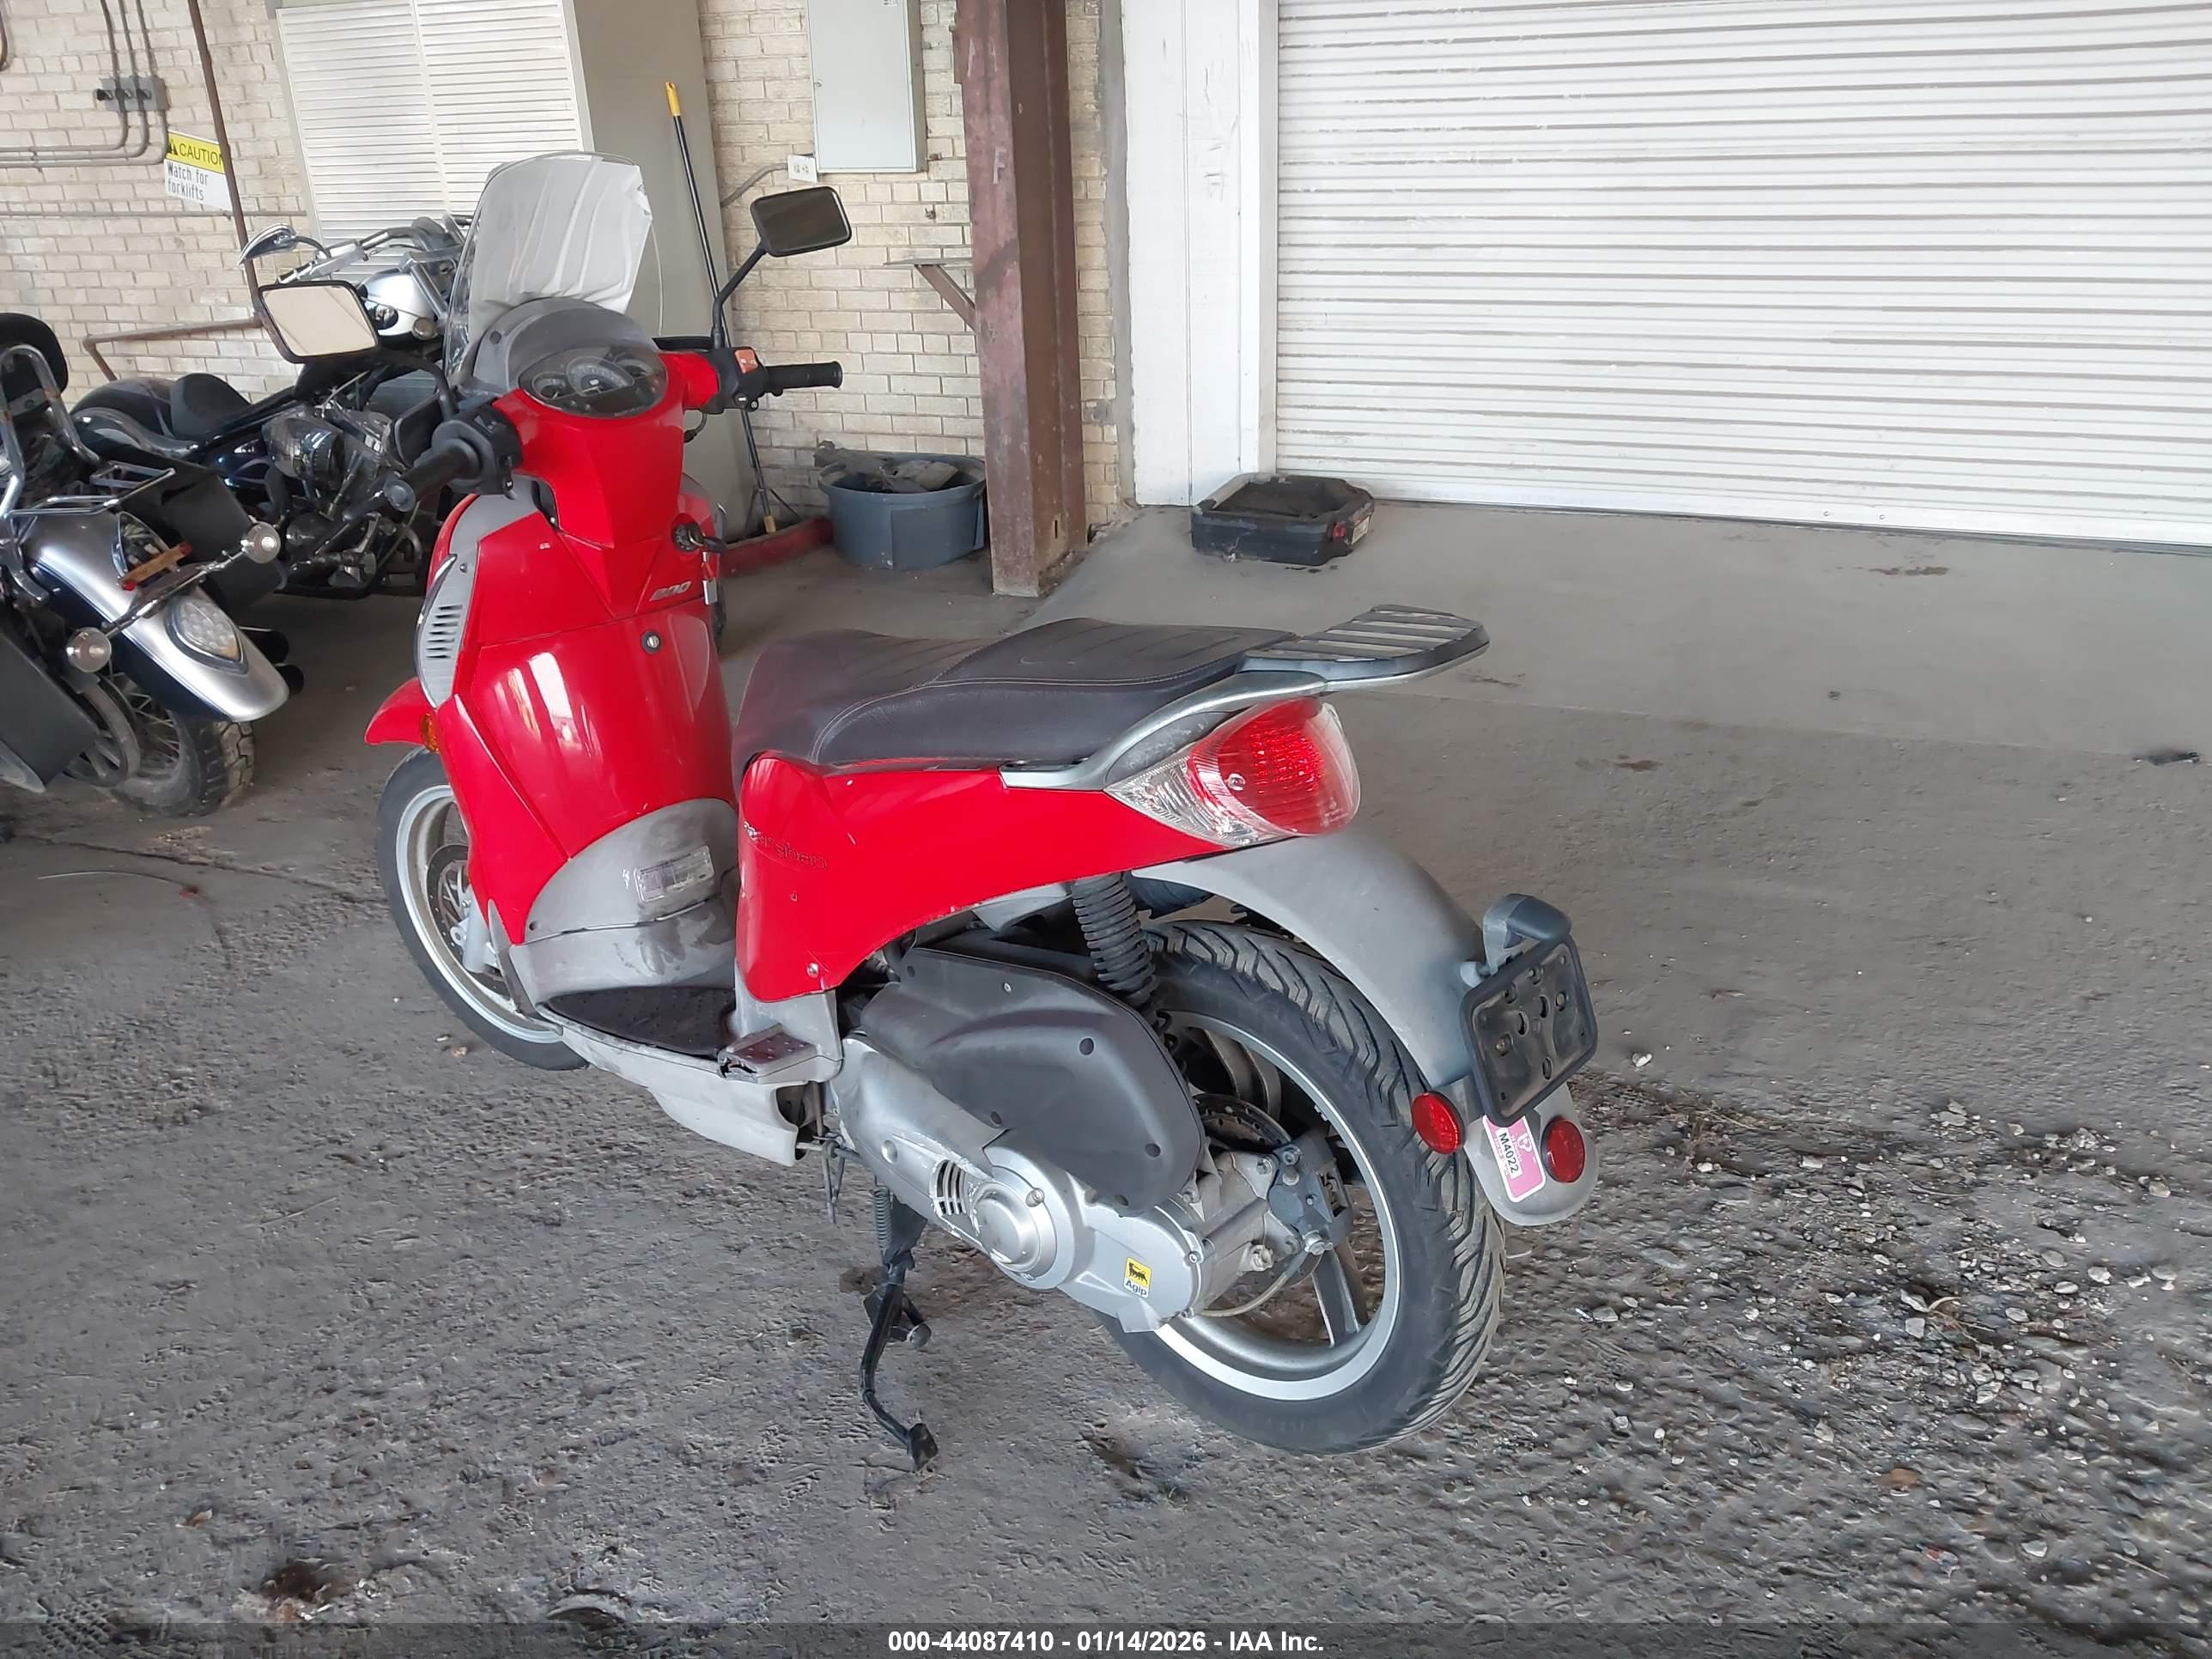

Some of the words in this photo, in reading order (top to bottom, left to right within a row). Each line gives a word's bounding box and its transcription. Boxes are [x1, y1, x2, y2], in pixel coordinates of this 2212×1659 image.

[167, 161, 191, 181] Watch
[197, 169, 209, 185] for
[168, 179, 204, 201] forklifts
[1498, 1132, 1519, 1174] M4022
[1126, 1279, 1147, 1296] Agip
